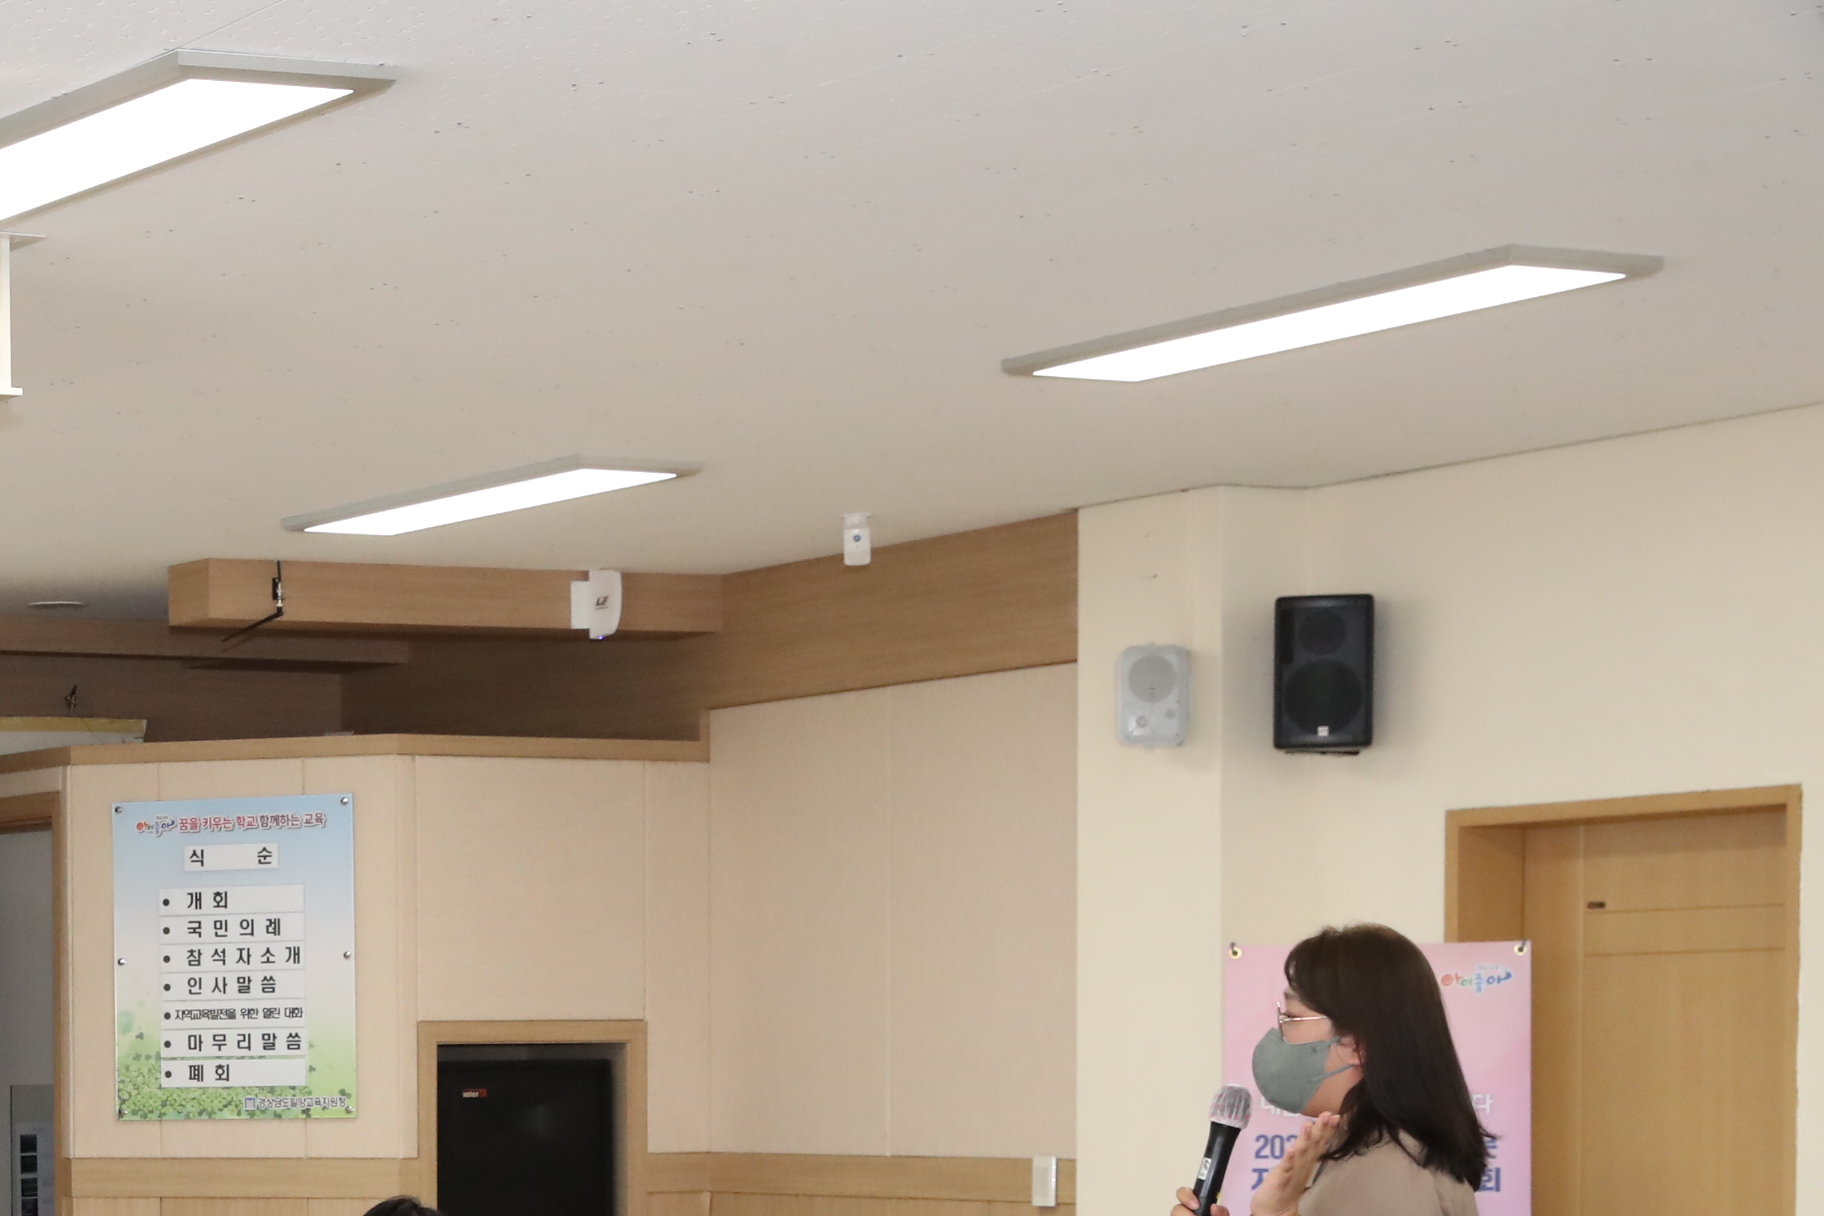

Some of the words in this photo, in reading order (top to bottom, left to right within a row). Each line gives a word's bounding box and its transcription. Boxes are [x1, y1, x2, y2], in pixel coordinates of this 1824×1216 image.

[179, 816, 201, 831] 꿈을
[202, 816, 234, 830] 키우는
[236, 815, 257, 829] 학교
[259, 814, 301, 828] 함께하는
[303, 813, 326, 826] 교육
[240, 1007, 260, 1020] 위한
[262, 1007, 281, 1020] 열린
[284, 1006, 304, 1019] 대화
